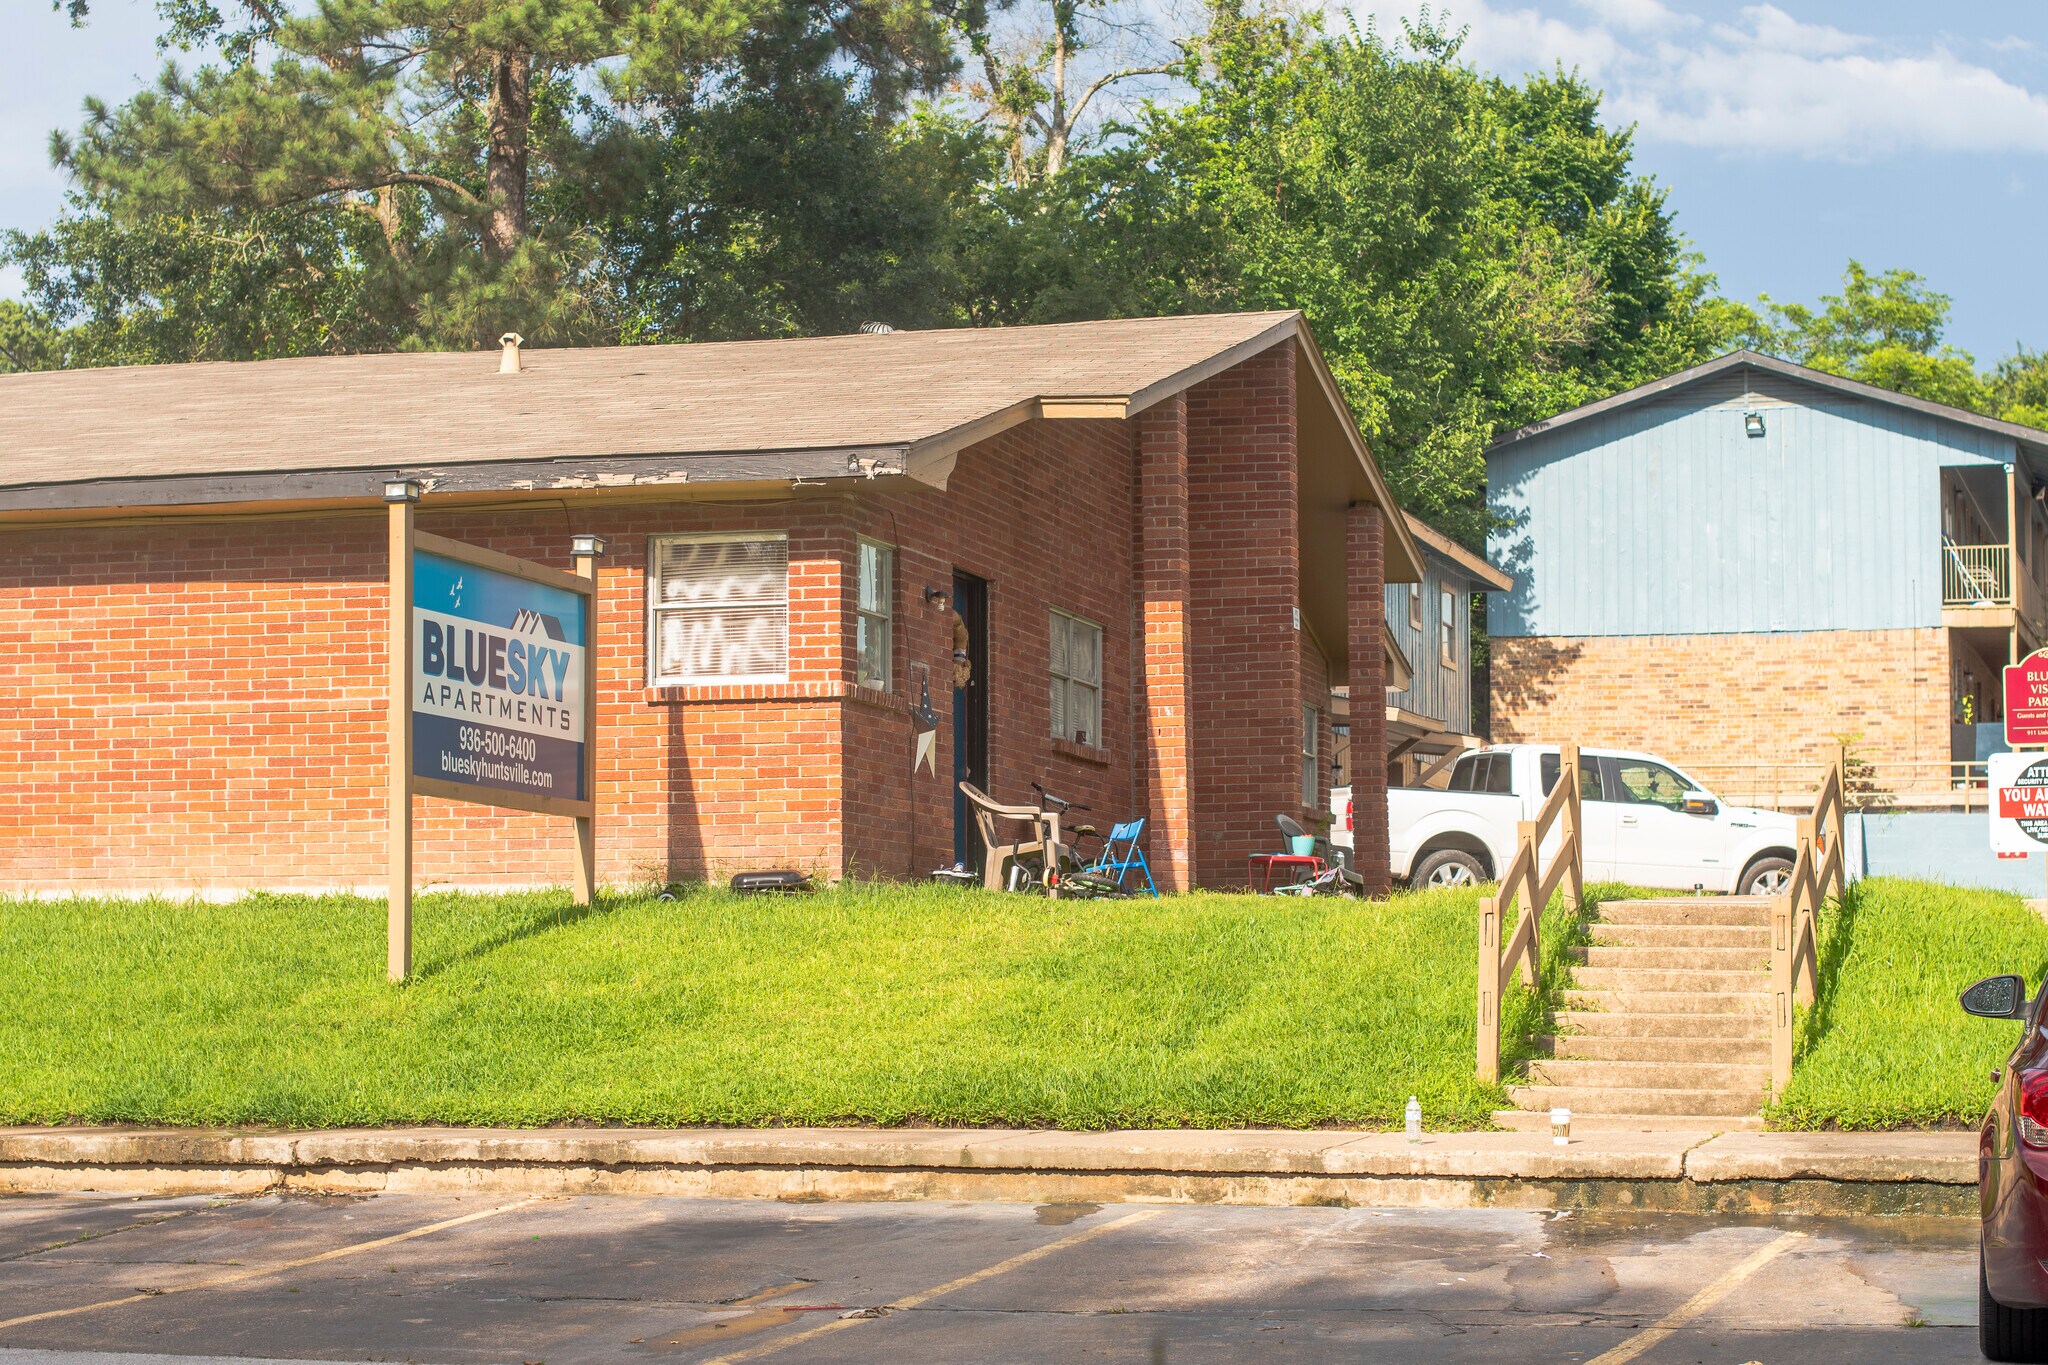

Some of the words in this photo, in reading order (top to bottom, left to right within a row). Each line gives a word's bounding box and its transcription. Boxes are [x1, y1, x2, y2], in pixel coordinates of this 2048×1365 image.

[423, 619, 571, 703] BLUESKY
[423, 682, 571, 731] APARTMENTS
[459, 725, 536, 762] 936-500-6400
[441, 750, 553, 789] blueskyhuntsville.com
[2002, 788, 2031, 802] YOU
